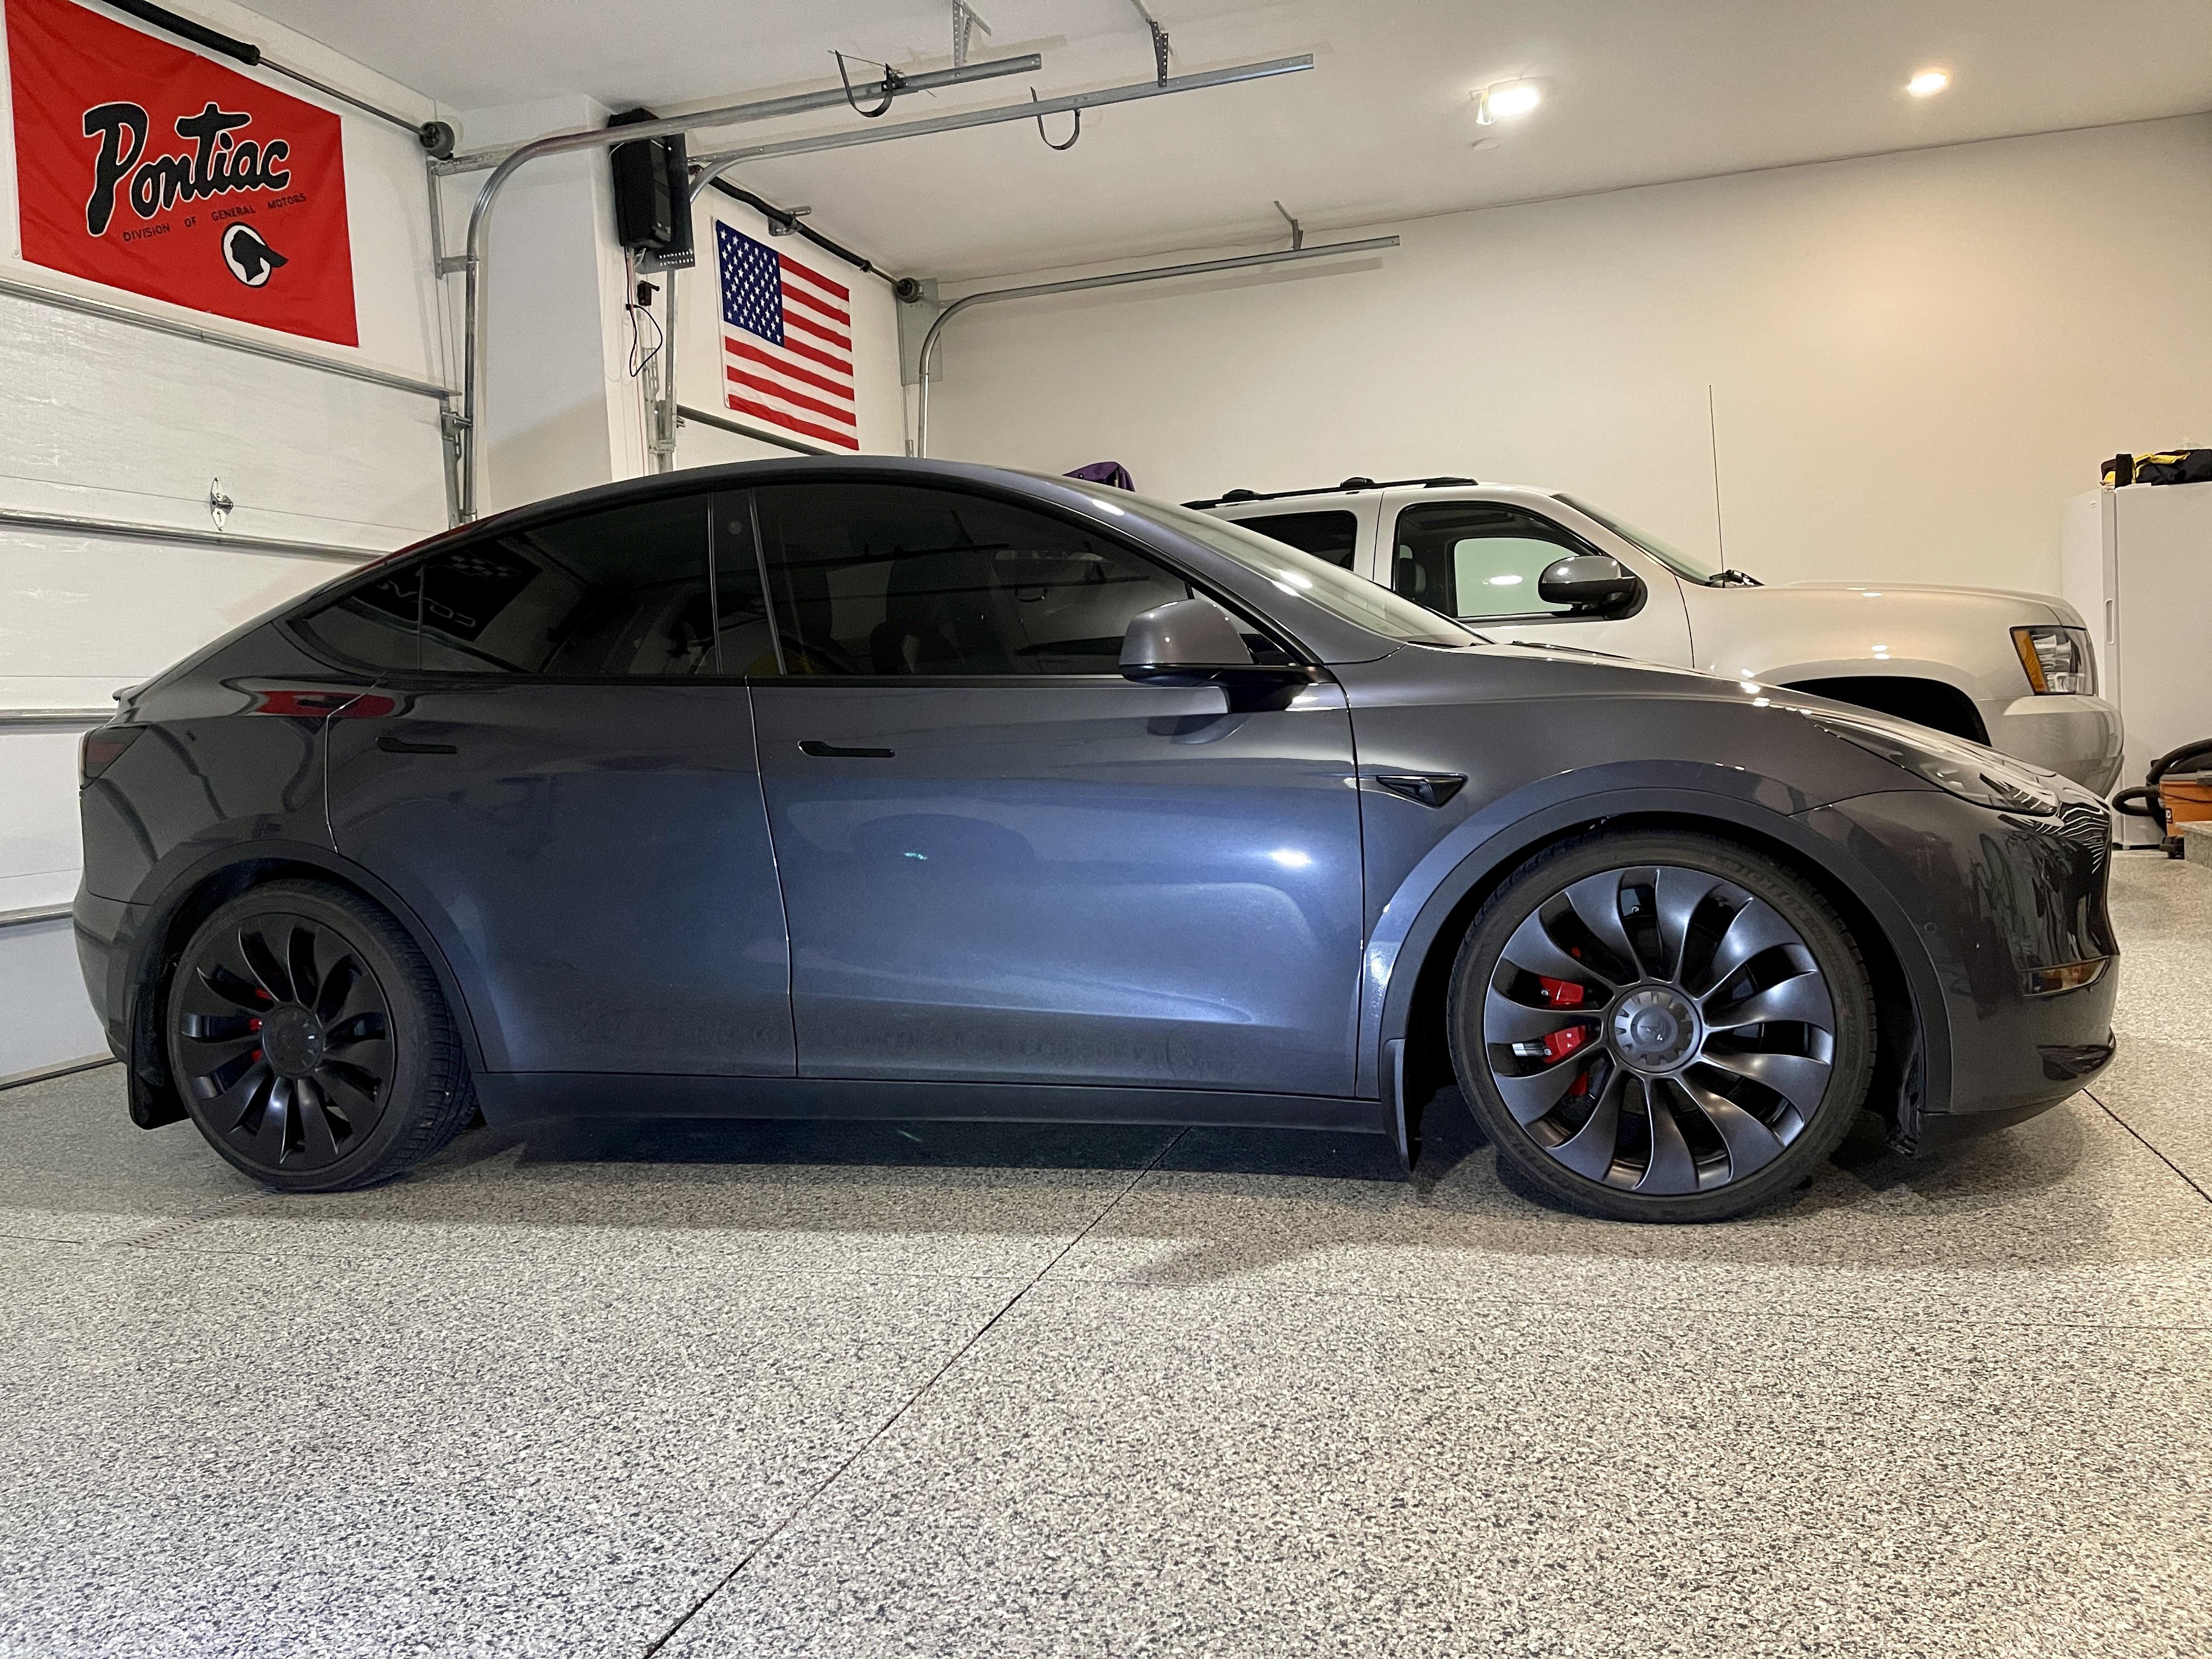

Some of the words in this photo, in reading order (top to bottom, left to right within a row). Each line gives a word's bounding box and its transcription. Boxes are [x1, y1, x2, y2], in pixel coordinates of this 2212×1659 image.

[83, 101, 291, 238] Pontiac
[122, 223, 171, 242] DIVISION
[184, 216, 196, 228] OF
[211, 205, 256, 221] GENERAL
[267, 193, 307, 210] MOTORS
